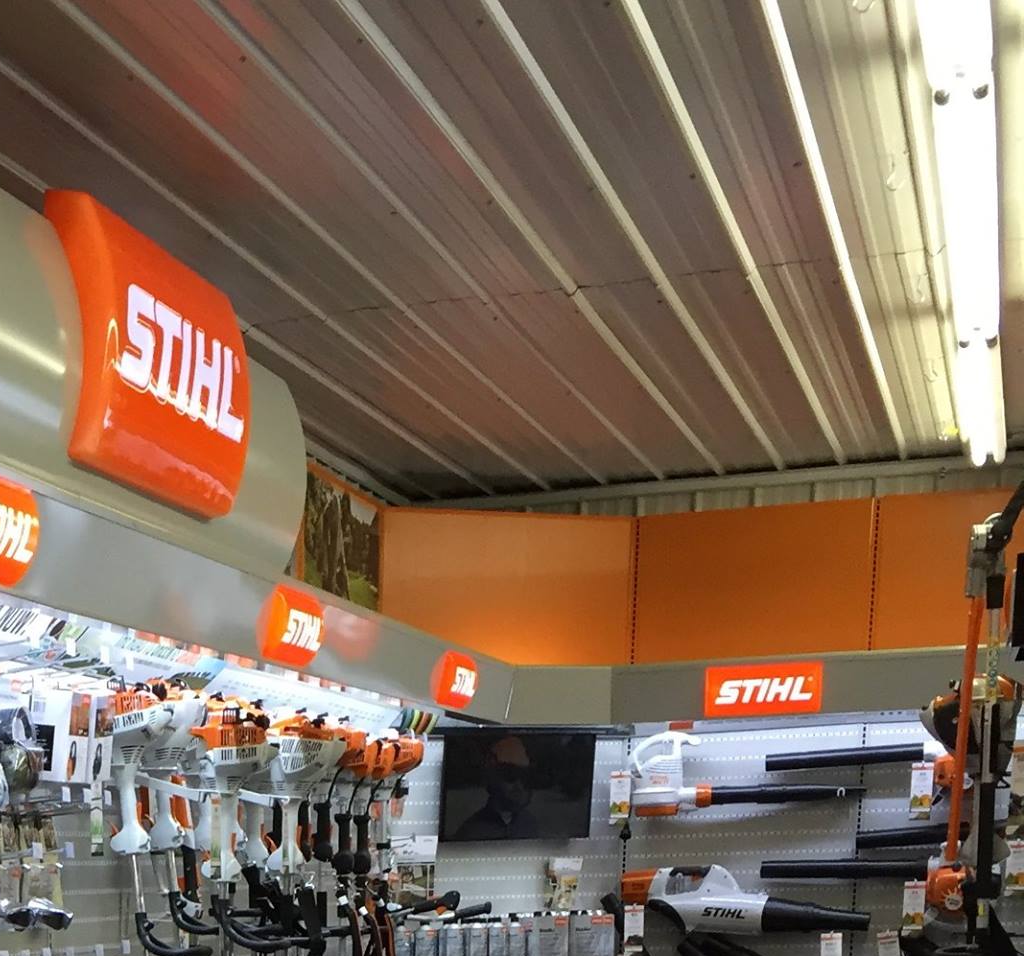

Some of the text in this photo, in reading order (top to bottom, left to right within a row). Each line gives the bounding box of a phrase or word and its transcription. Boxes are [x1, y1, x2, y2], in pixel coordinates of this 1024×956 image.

[115, 284, 244, 443] STIHL
[282, 608, 322, 652] STIHL
[451, 666, 476, 698] STIHL
[714, 676, 813, 705] STIHL
[701, 906, 745, 919] STIHL
